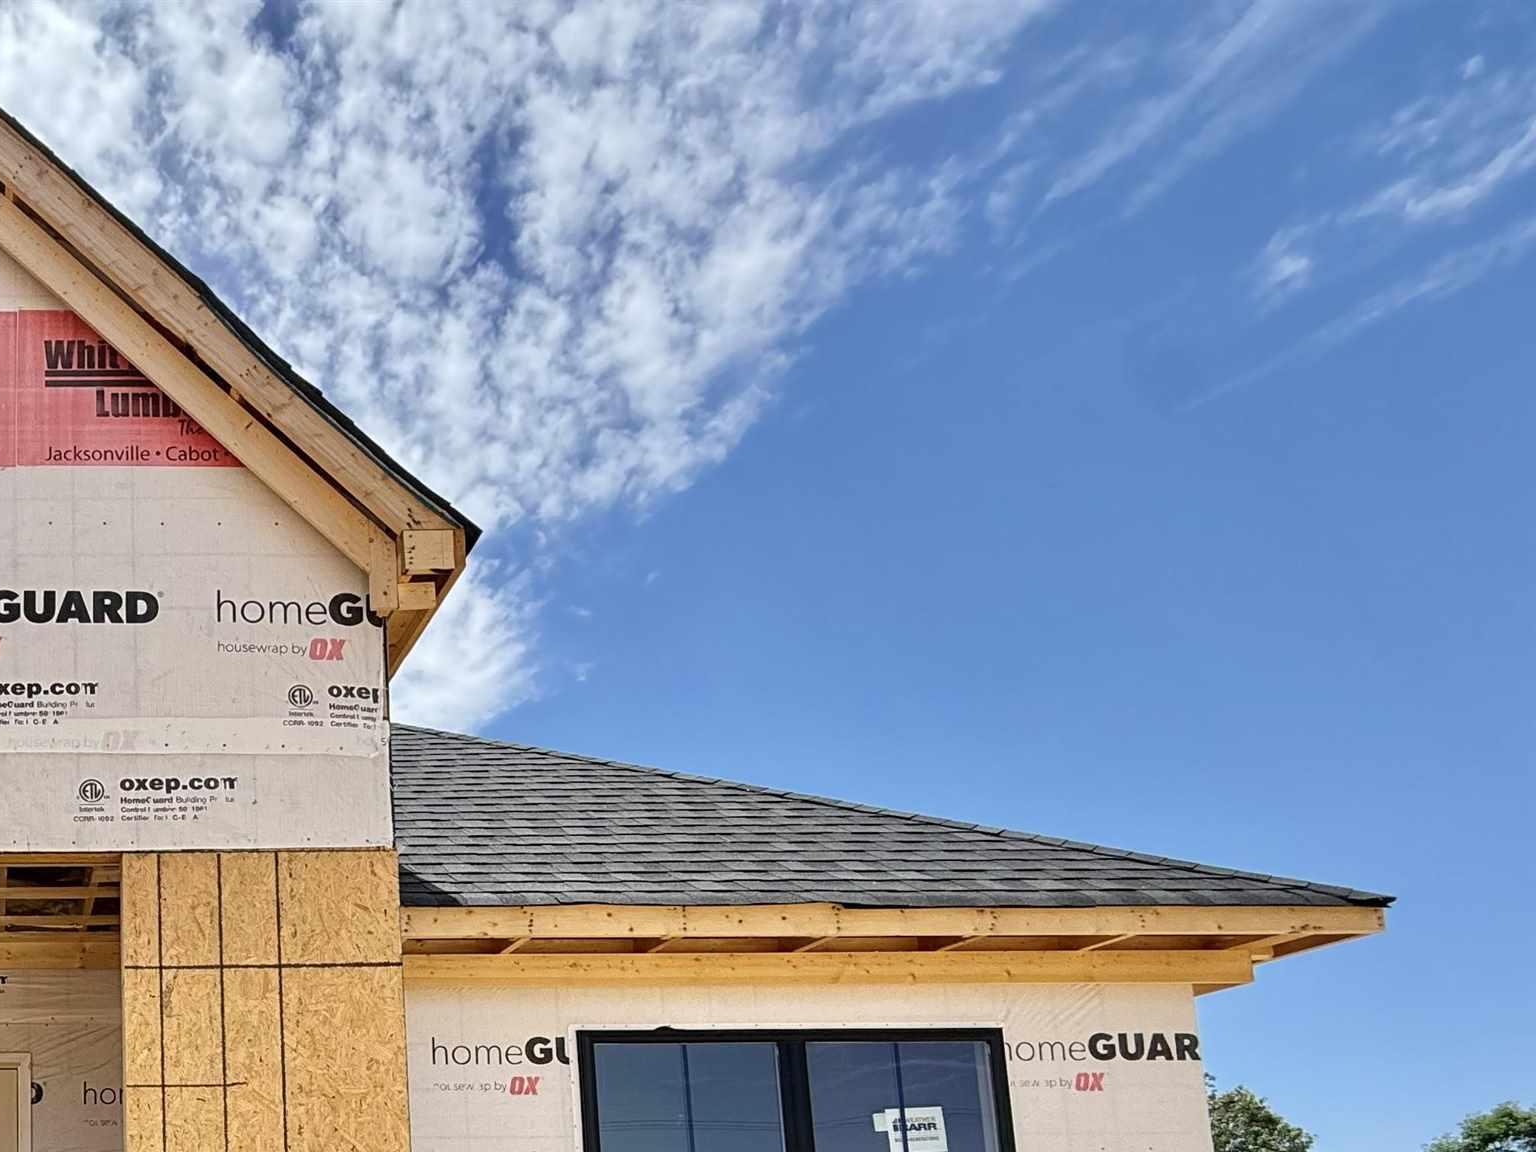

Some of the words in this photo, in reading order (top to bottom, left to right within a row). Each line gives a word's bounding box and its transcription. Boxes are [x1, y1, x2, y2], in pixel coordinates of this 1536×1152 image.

[45, 446, 151, 462] Jacksonville
[166, 446, 219, 463] Cabot
[216, 640, 291, 657] housewrap
[292, 640, 308, 657] by
[308, 636, 348, 662] OX
[494, 1079, 507, 1094] by
[508, 1076, 542, 1096] OX
[1059, 1077, 1073, 1090] by
[1075, 1072, 1105, 1091] OX
